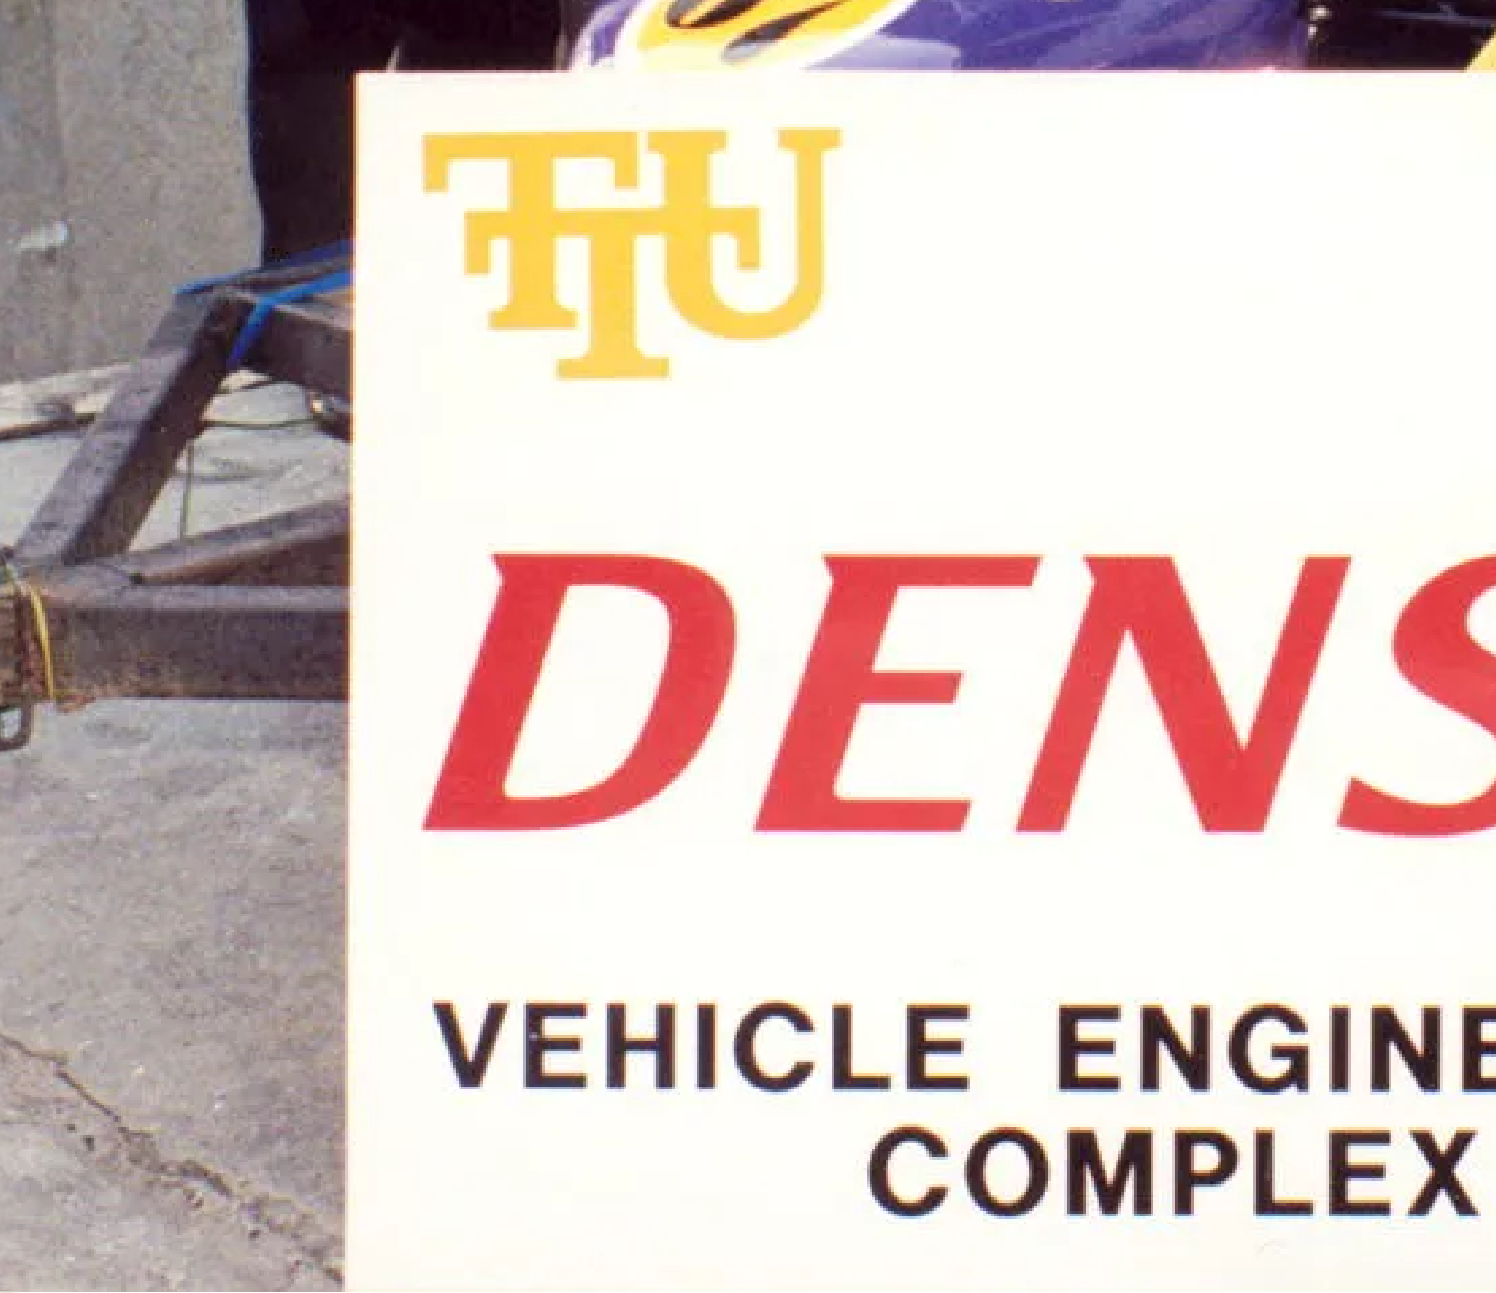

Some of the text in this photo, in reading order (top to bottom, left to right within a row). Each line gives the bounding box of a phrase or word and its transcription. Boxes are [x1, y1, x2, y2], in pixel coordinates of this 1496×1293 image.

[422, 126, 844, 382] TTU
[434, 1001, 970, 1094] VEHICLE
[868, 1126, 1480, 1218] COMPLEX
